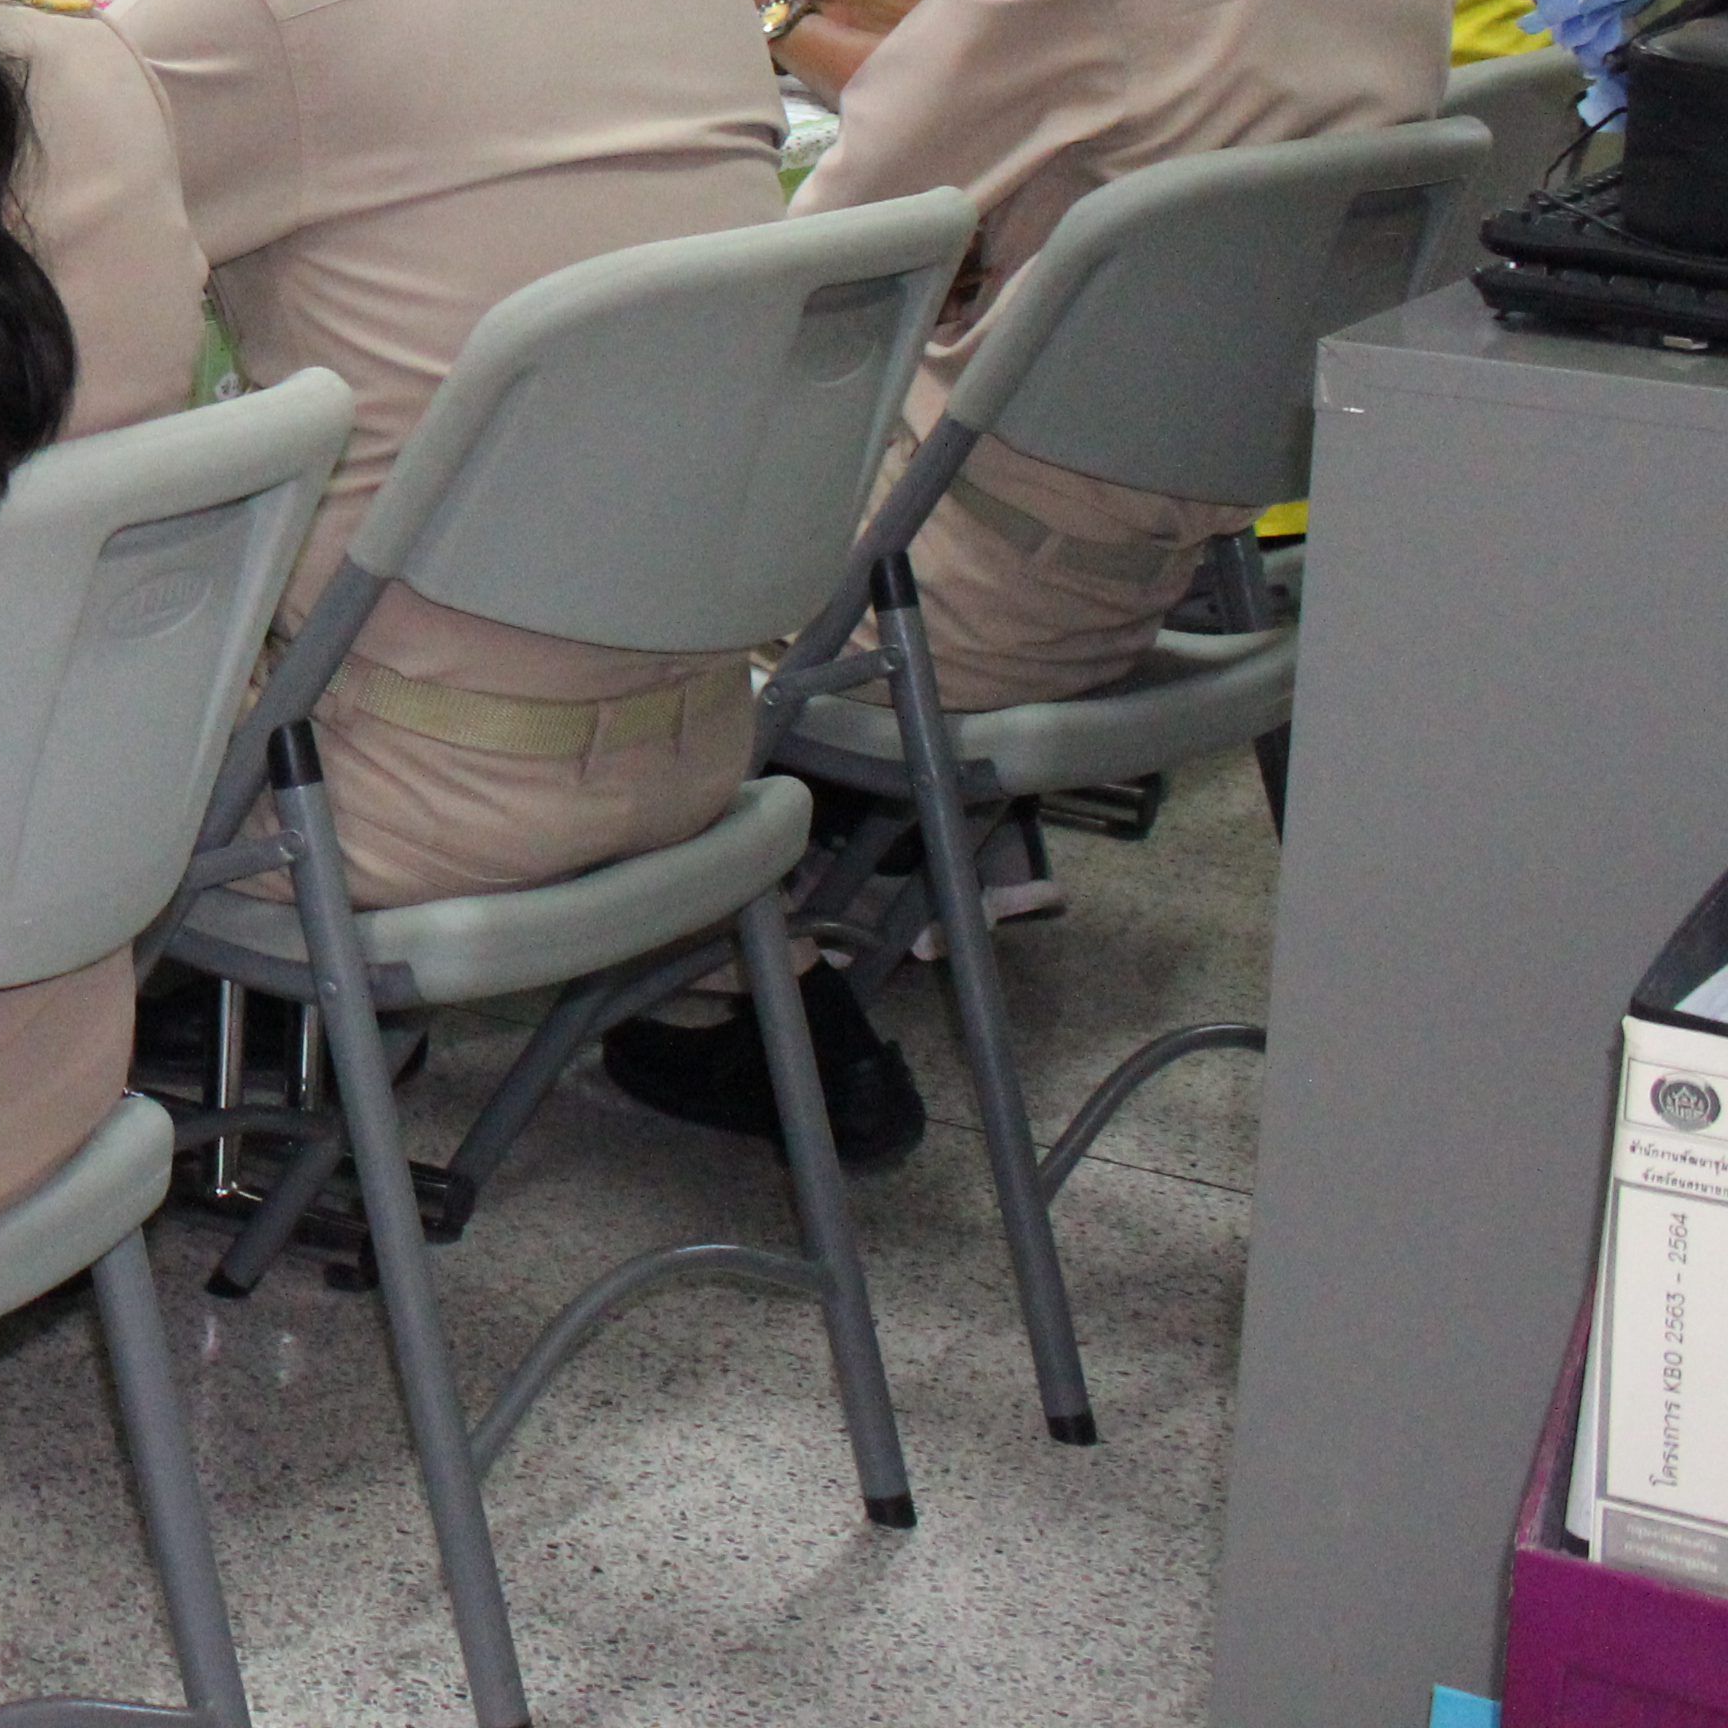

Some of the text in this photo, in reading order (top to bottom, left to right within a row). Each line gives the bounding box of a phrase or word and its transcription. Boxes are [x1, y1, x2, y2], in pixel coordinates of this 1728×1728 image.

[1668, 1211, 1689, 1265] 2564
[1664, 1291, 1687, 1345] 2563
[1662, 1350, 1686, 1396] KBO
[1648, 1400, 1682, 1489] โครงการ
